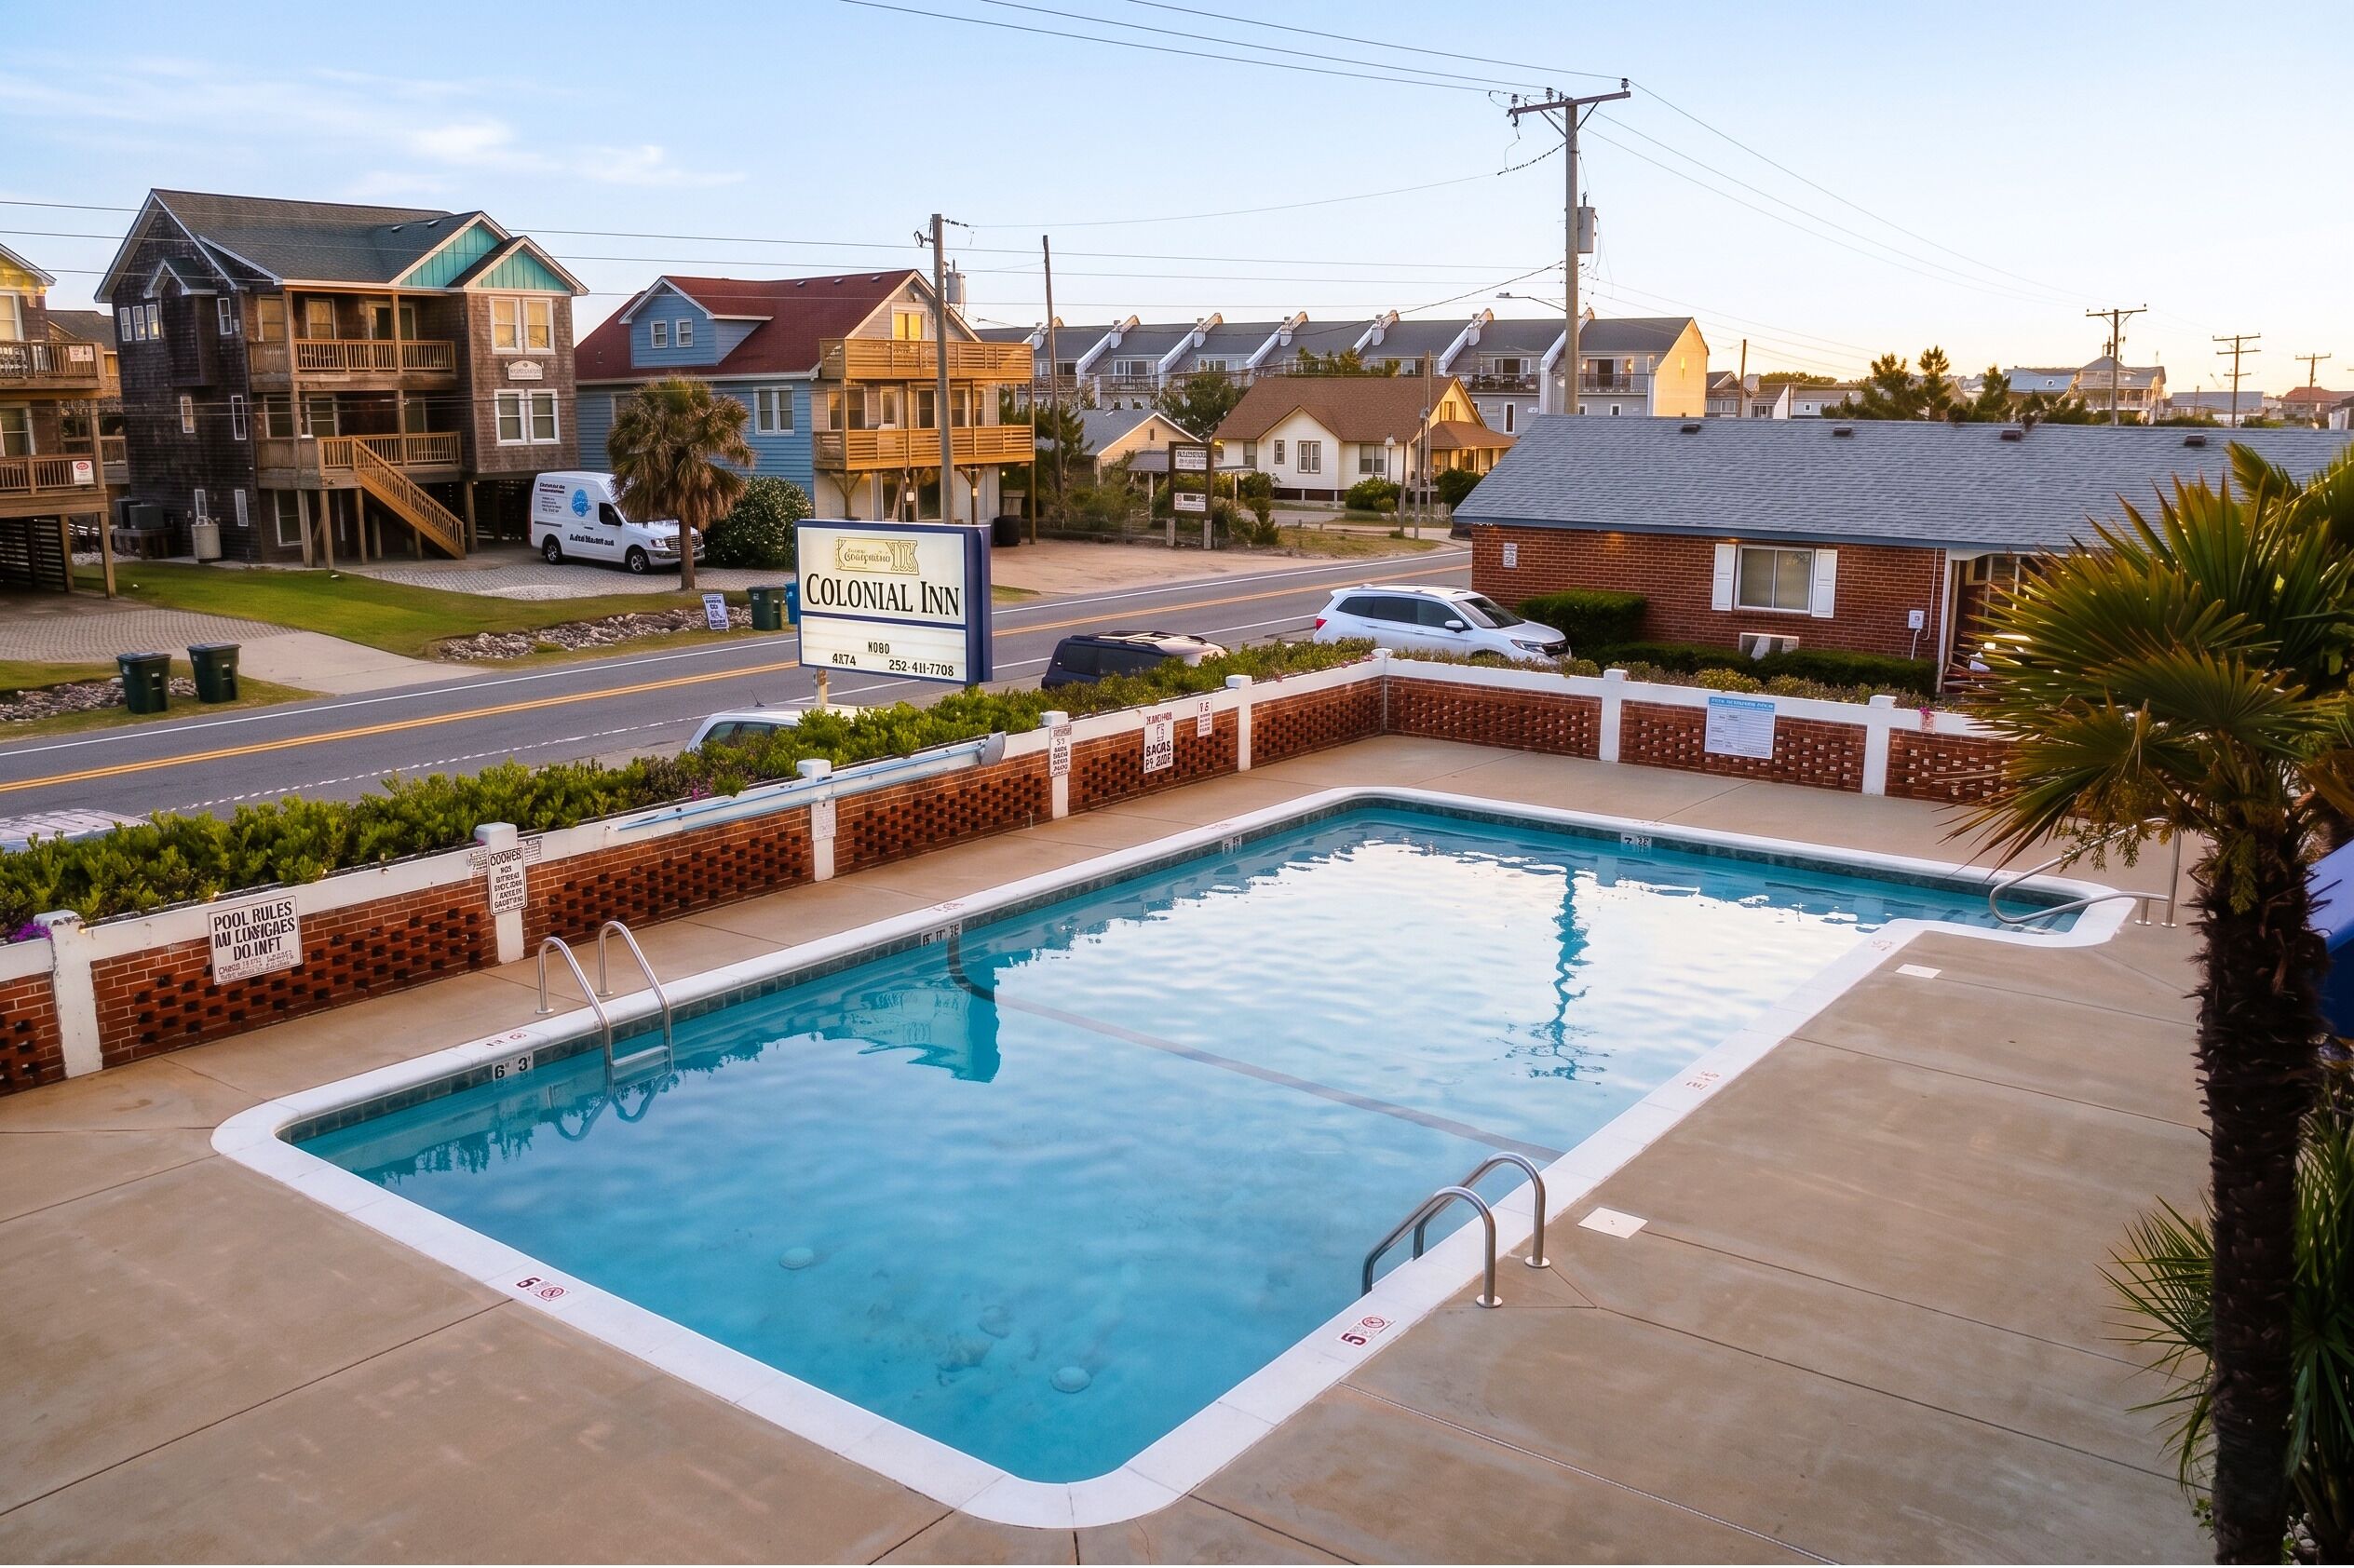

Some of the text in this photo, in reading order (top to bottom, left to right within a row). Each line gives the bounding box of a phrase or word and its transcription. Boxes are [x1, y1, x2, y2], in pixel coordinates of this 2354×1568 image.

[806, 573, 960, 616] COLONIAL INN
[214, 900, 292, 932] POOL RULES
